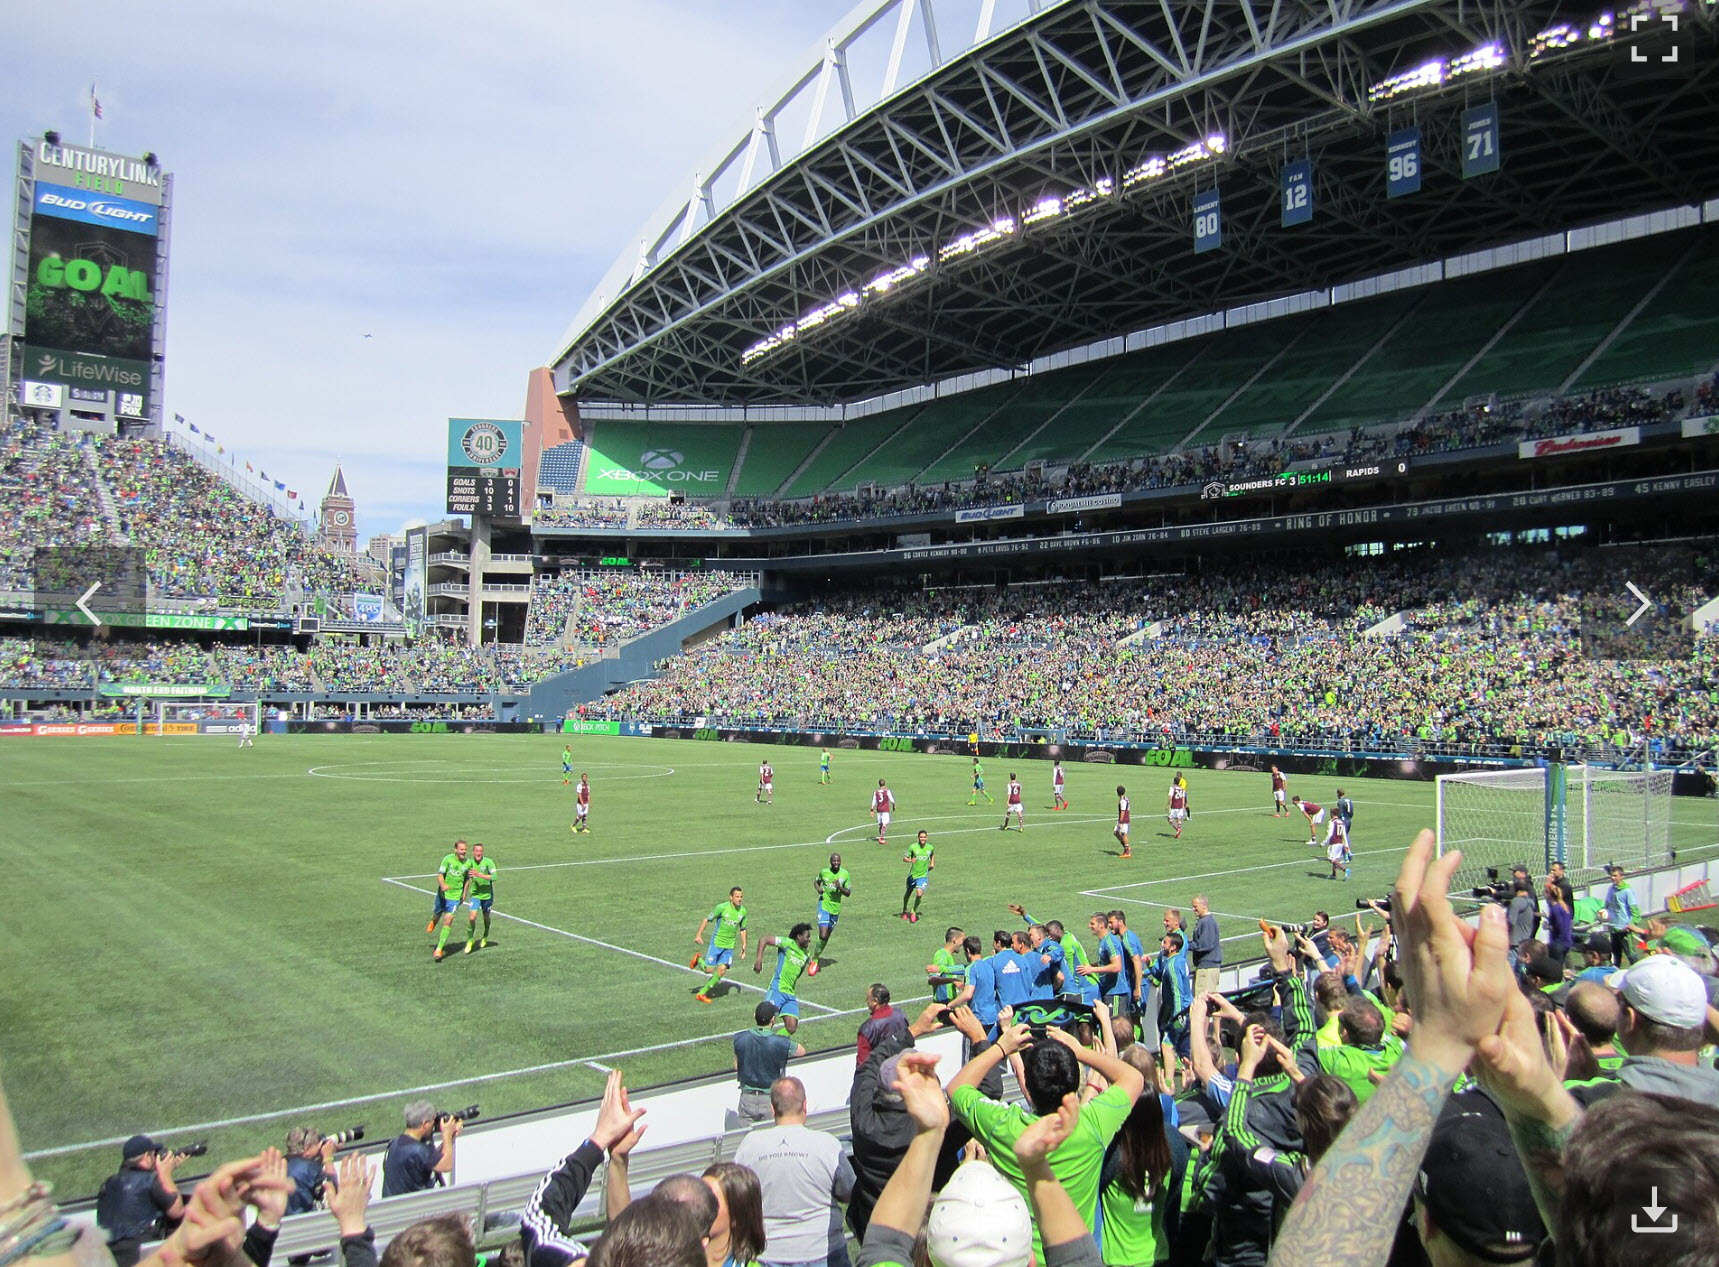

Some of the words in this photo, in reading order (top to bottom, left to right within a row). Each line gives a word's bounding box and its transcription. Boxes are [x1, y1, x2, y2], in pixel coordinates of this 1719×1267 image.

[1467, 131, 1493, 160] 71
[40, 142, 159, 187] CENTURYLINK
[1389, 153, 1417, 181] 96
[75, 173, 124, 195] FIELD
[1289, 173, 1303, 182] FAN
[1286, 184, 1307, 211] 12
[40, 194, 87, 210] BUD
[95, 205, 153, 222] LIGHT
[1196, 212, 1218, 238] 80
[37, 256, 149, 300] GOAL
[60, 360, 141, 385] LifeWise
[475, 435, 493, 451] 40
[596, 469, 665, 482] XBOX
[667, 470, 719, 481] ONE
[1346, 466, 1380, 478] RAPIDS
[1398, 463, 1406, 473] 0
[507, 479, 513, 487] 0
[1229, 480, 1273, 492] SOUNDERS
[1275, 478, 1286, 487] FC
[1289, 477, 1296, 486] 3
[1300, 472, 1329, 484] 51:14
[1635, 483, 1649, 494] 45
[1653, 480, 1680, 491] KENNY
[1684, 476, 1717, 488] EASLEY
[484, 487, 494, 495] 10
[448, 495, 480, 503] CORNERS
[1286, 516, 1312, 530] RING
[1319, 514, 1332, 527] OF
[1339, 510, 1377, 525] HONOR
[1181, 529, 1190, 538] 80
[1192, 527, 1210, 536] STEVE
[601, 557, 631, 566] GOAL
[126, 613, 170, 628] GREEN
[174, 616, 211, 629] ZONE
[880, 737, 913, 751] GOAL
[1145, 749, 1195, 767] GOAL
[878, 792, 884, 802] 3
[1013, 787, 1019, 795] 6
[1336, 824, 1344, 835] 17
